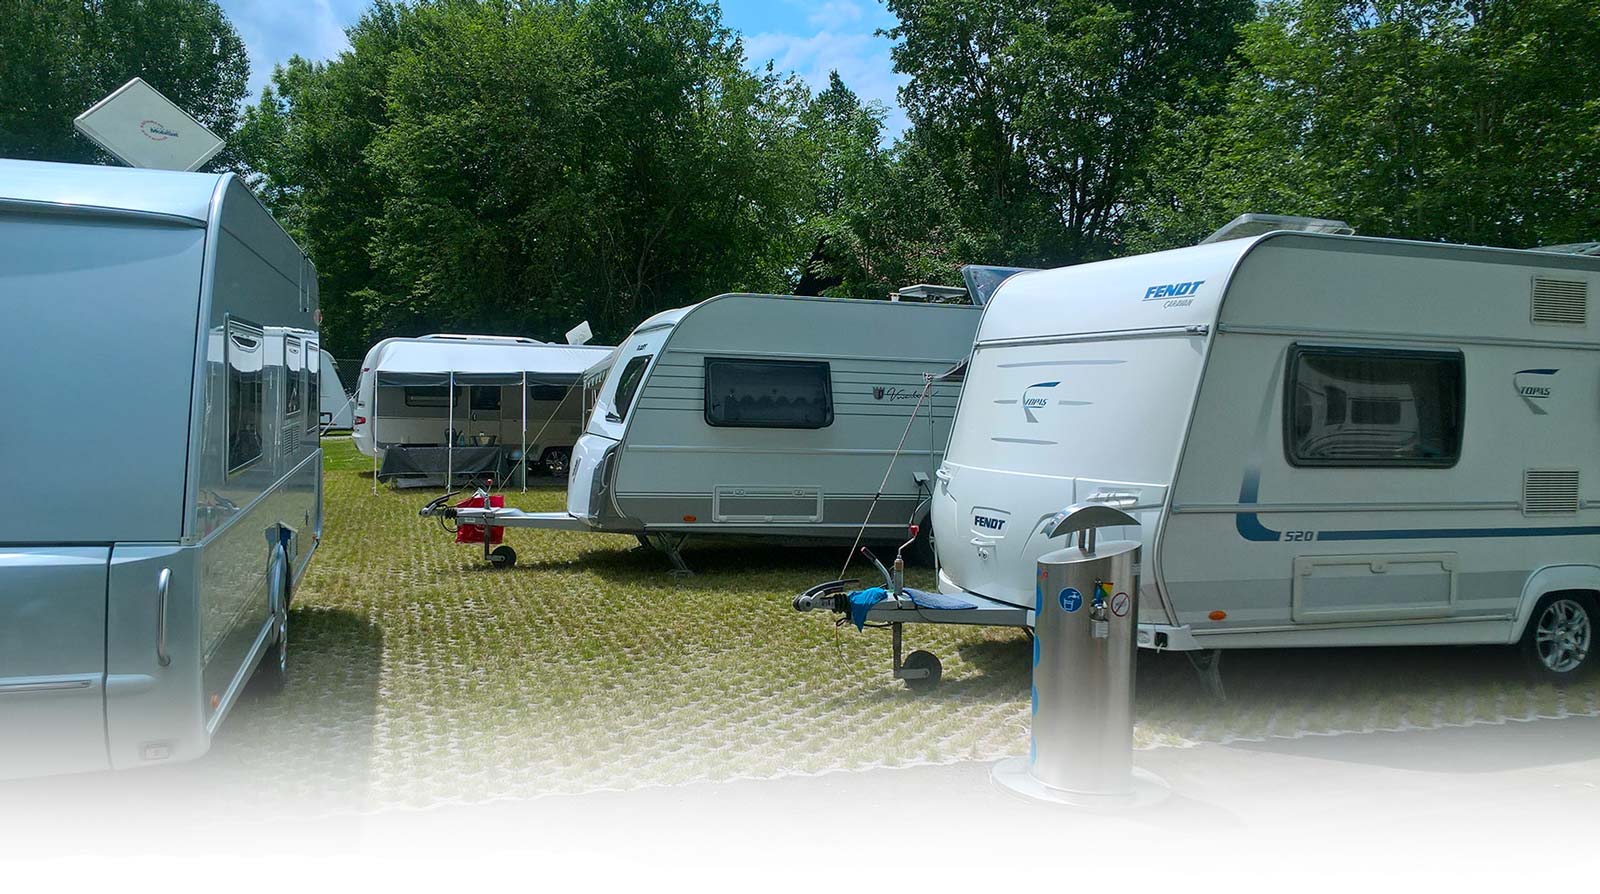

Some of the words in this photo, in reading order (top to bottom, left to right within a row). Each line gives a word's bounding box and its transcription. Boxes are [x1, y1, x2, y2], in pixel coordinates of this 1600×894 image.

[1144, 280, 1206, 298] FENDT
[974, 515, 1006, 530] FENDT
[1284, 530, 1314, 542] 520
